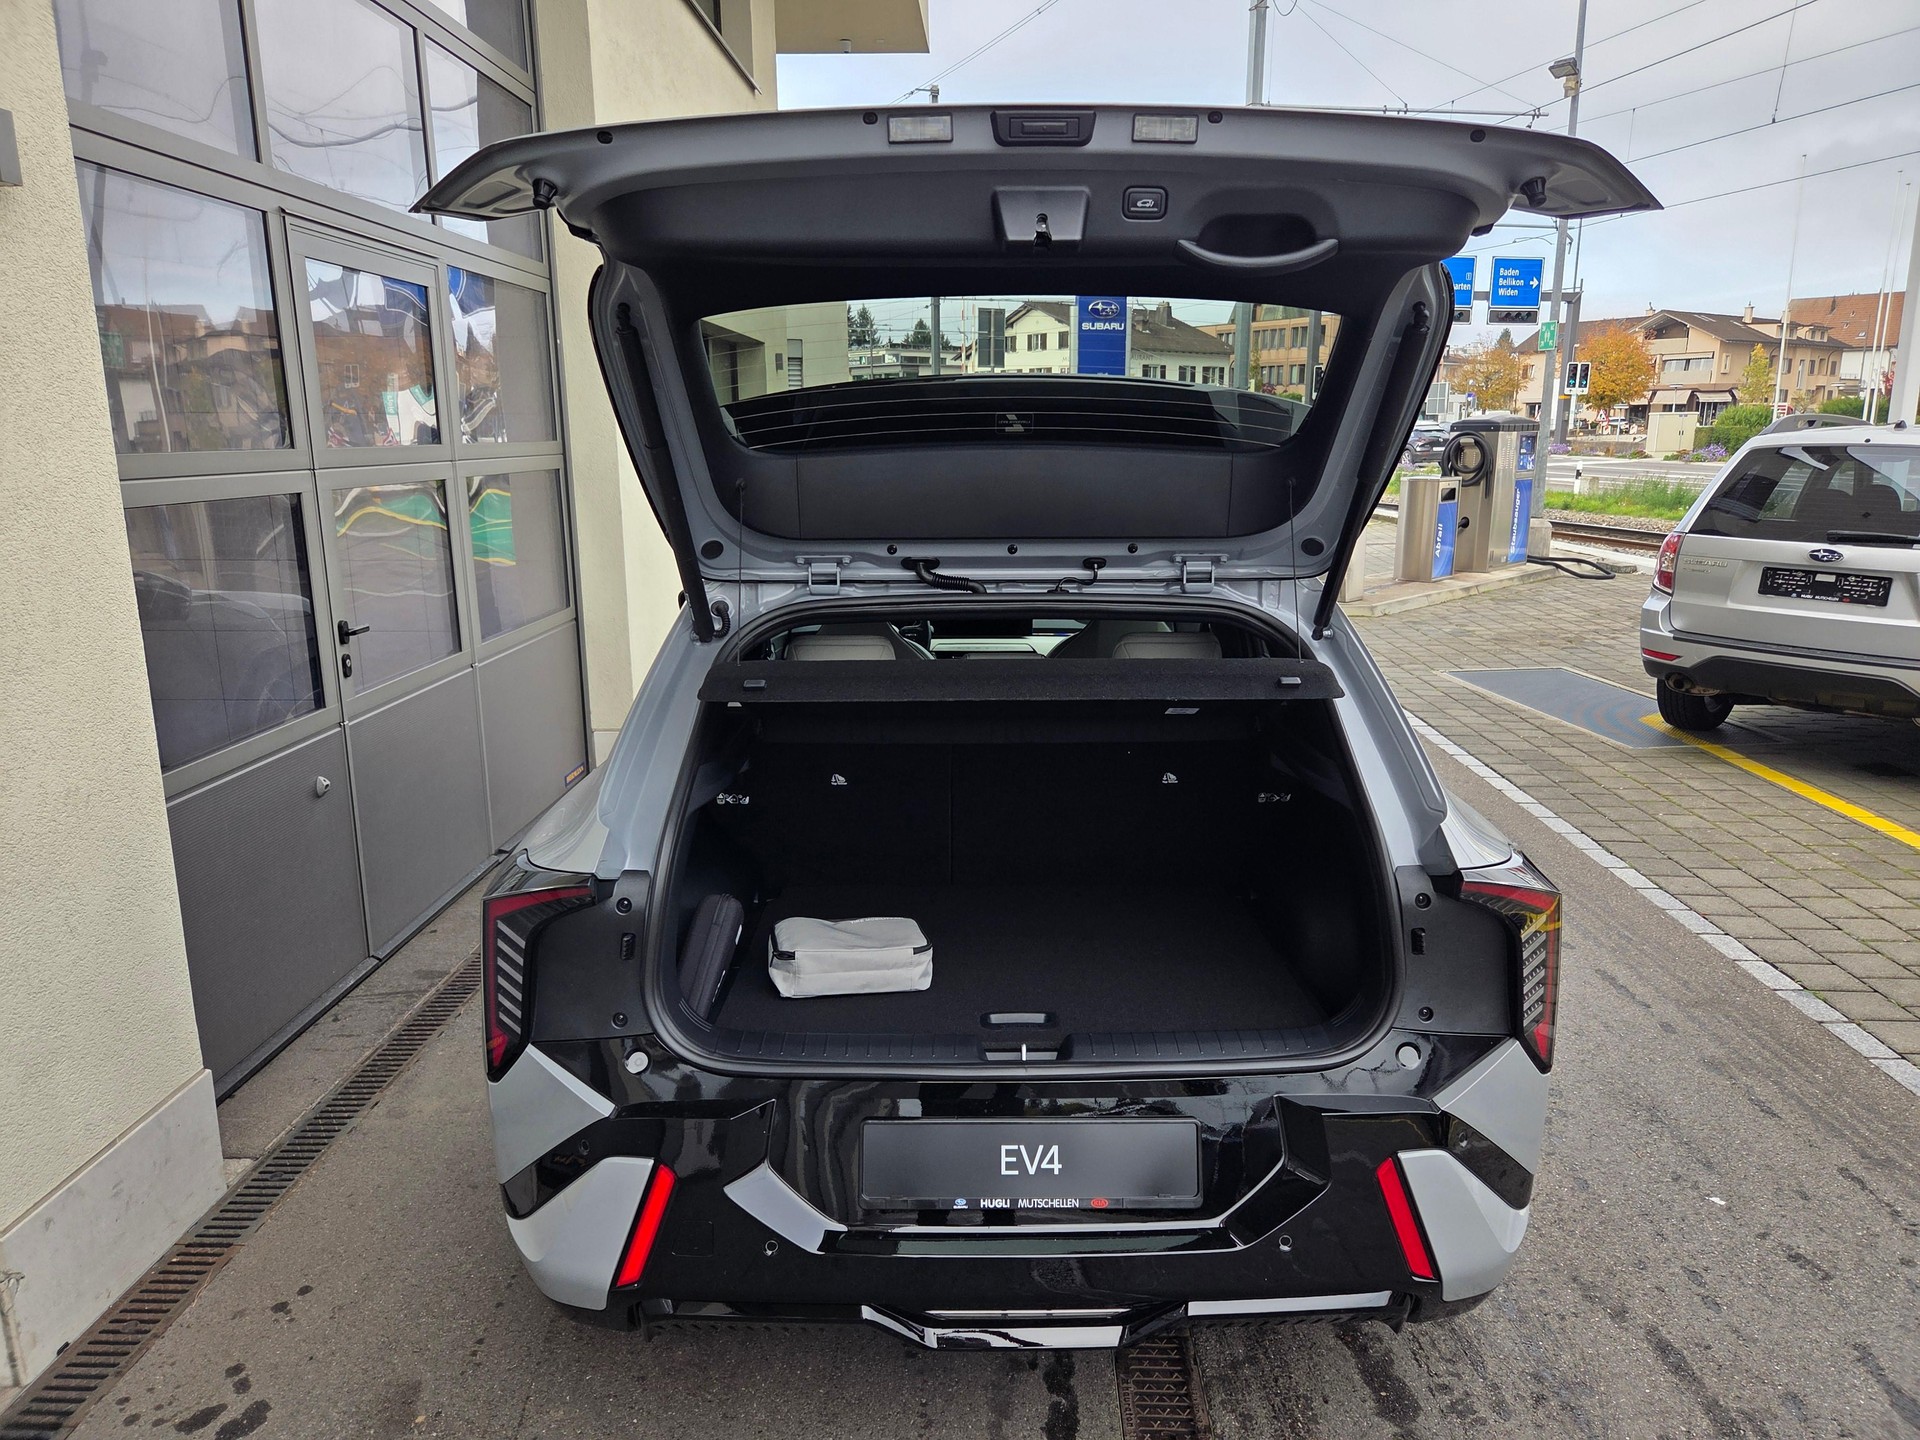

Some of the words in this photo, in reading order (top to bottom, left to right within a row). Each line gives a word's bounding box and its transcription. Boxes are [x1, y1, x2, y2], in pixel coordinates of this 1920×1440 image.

[1499, 267, 1519, 276] Baden
[1498, 277, 1524, 286] Bellikon
[1498, 287, 1518, 296] Widen
[1081, 322, 1125, 330] SUBARU
[1435, 523, 1443, 558] Abfall
[1000, 1144, 1063, 1176] EV4
[980, 1198, 1010, 1208] HUGLI
[1017, 1198, 1079, 1208] MUTSCHELLEN
